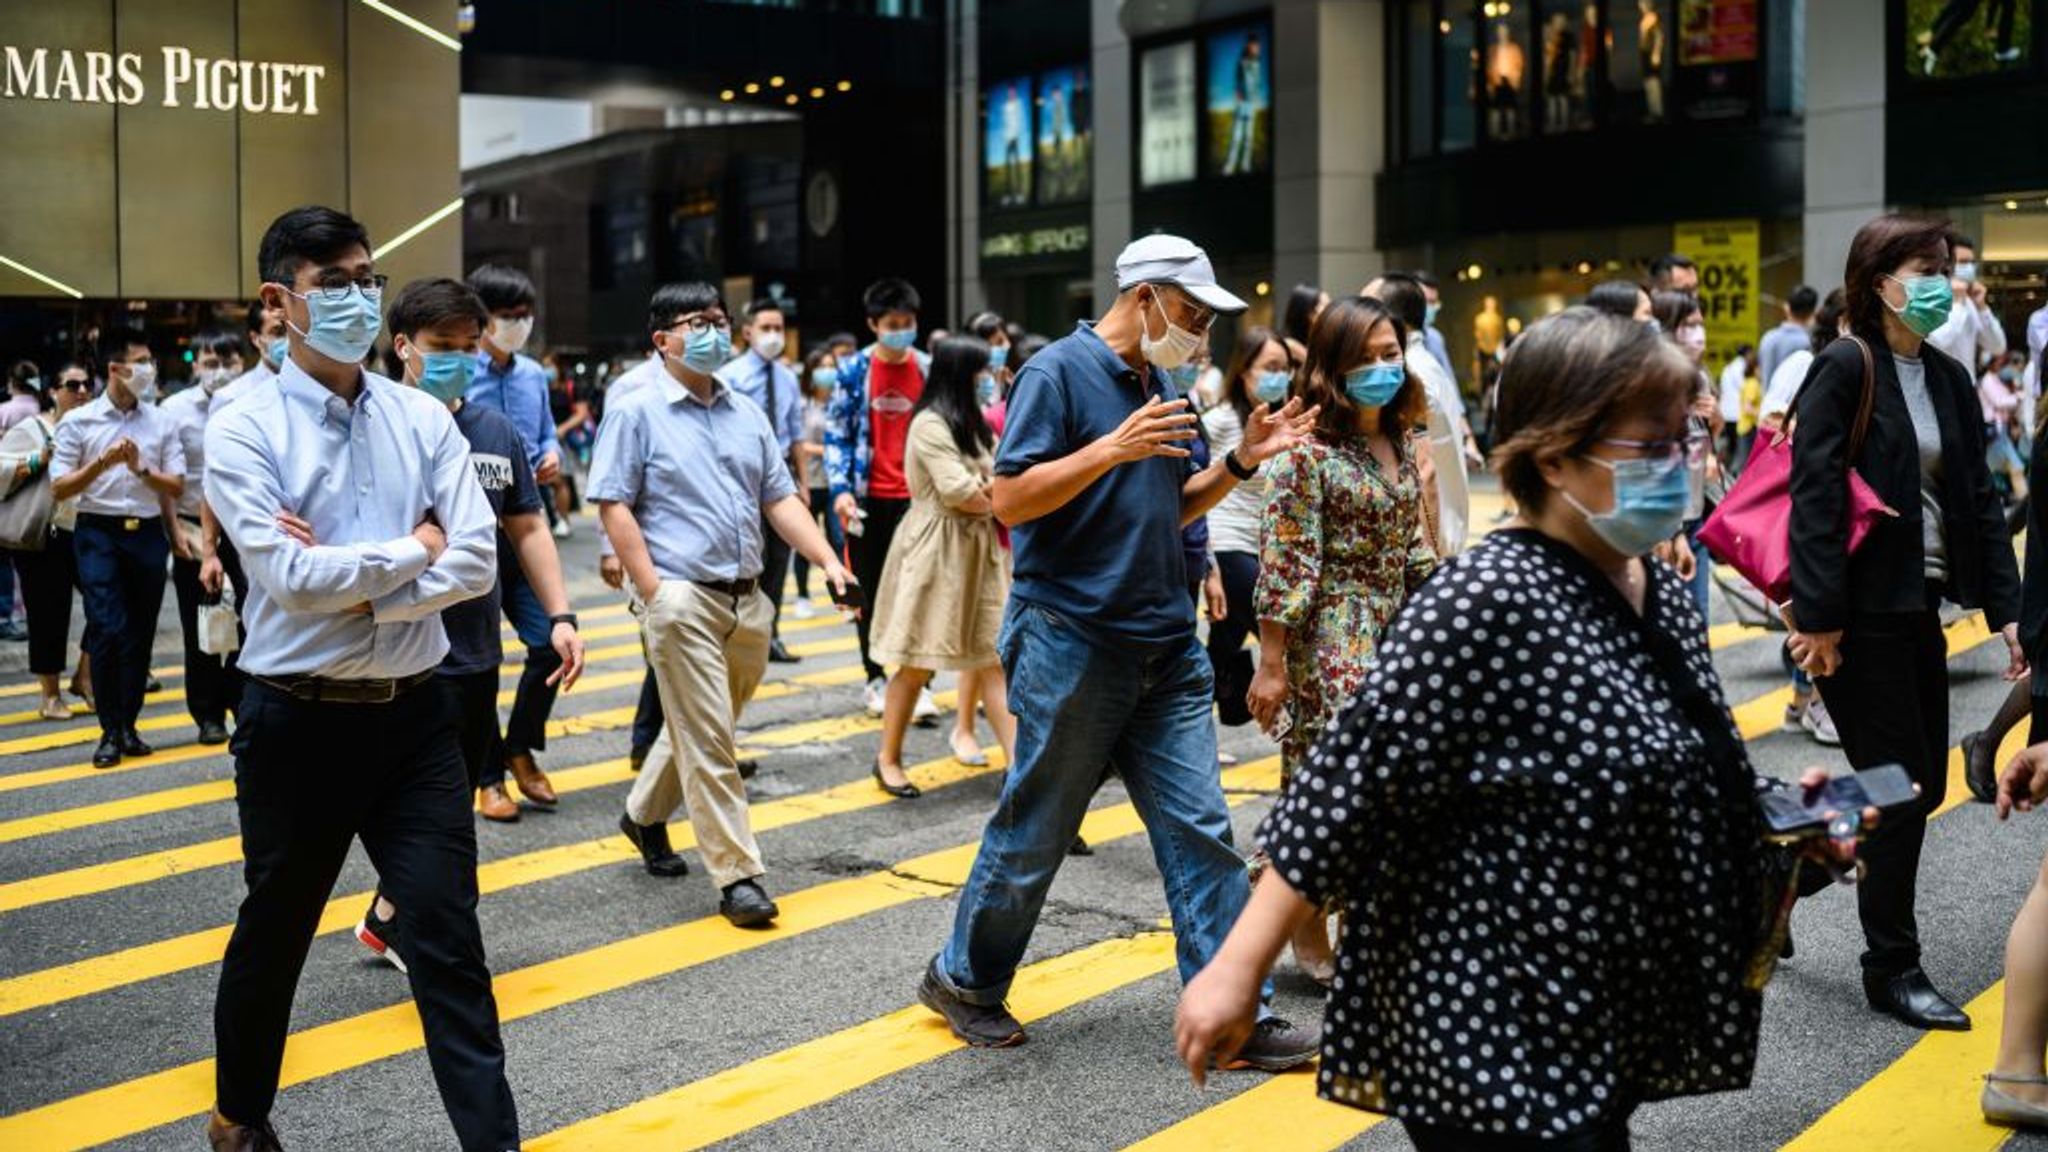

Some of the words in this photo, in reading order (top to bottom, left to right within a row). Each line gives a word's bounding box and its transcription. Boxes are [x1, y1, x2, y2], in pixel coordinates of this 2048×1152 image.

[3, 46, 144, 105] MARS
[161, 46, 325, 115] PIGUET
[1698, 264, 1749, 291] 0%
